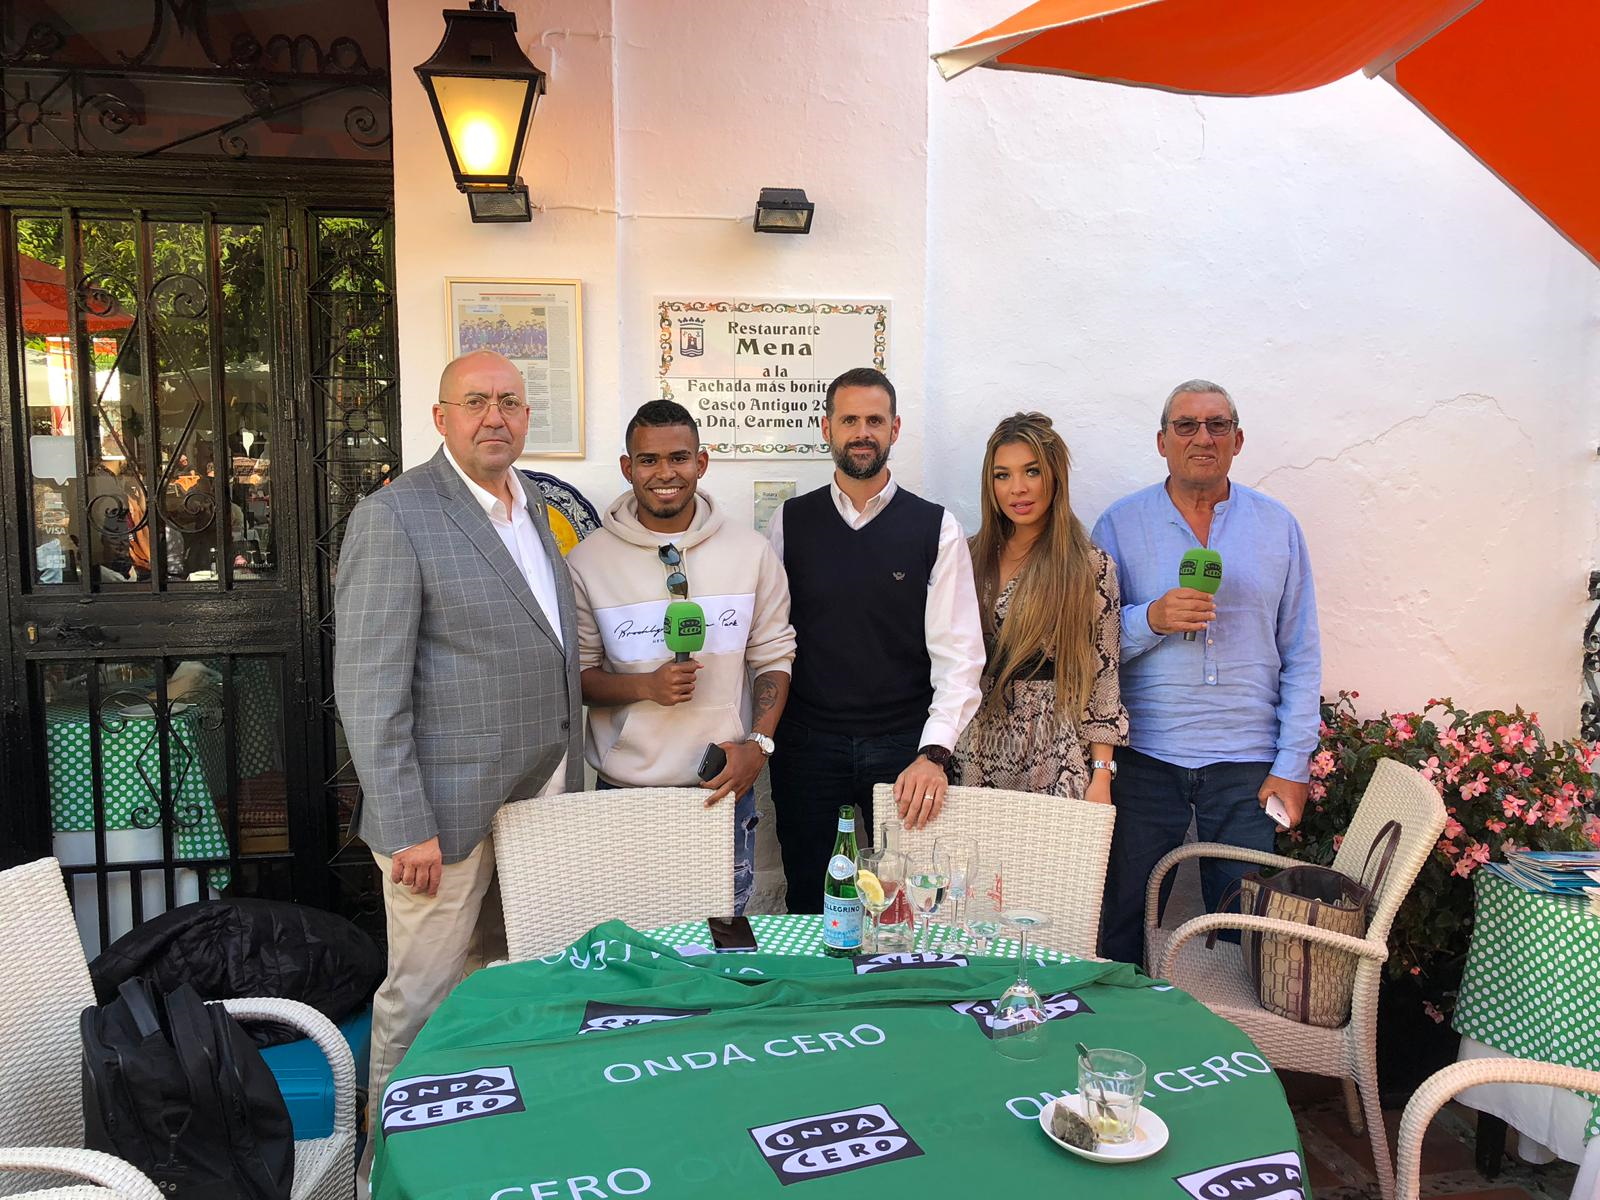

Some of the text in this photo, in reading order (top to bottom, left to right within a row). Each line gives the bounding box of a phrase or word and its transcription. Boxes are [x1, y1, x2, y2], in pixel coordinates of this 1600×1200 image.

[728, 321, 820, 335] Restaurante
[736, 338, 812, 356] Mena
[762, 365, 788, 377] a la
[687, 379, 830, 393] Fachada más bonit
[698, 398, 746, 411] Casco
[750, 398, 808, 413] Antiguo
[706, 415, 740, 429] Dña.
[744, 415, 803, 428] Carmen
[807, 416, 820, 428] M
[45, 526, 66, 535] VISA
[603, 1023, 886, 1083] ONDA CERO
[1153, 1051, 1272, 1092] CERO
[391, 1079, 495, 1101] ONDA
[399, 1097, 499, 1121] CERO
[775, 1117, 875, 1146] ONDA
[797, 1139, 892, 1167] CERO
[1207, 1167, 1301, 1198] ONDA
